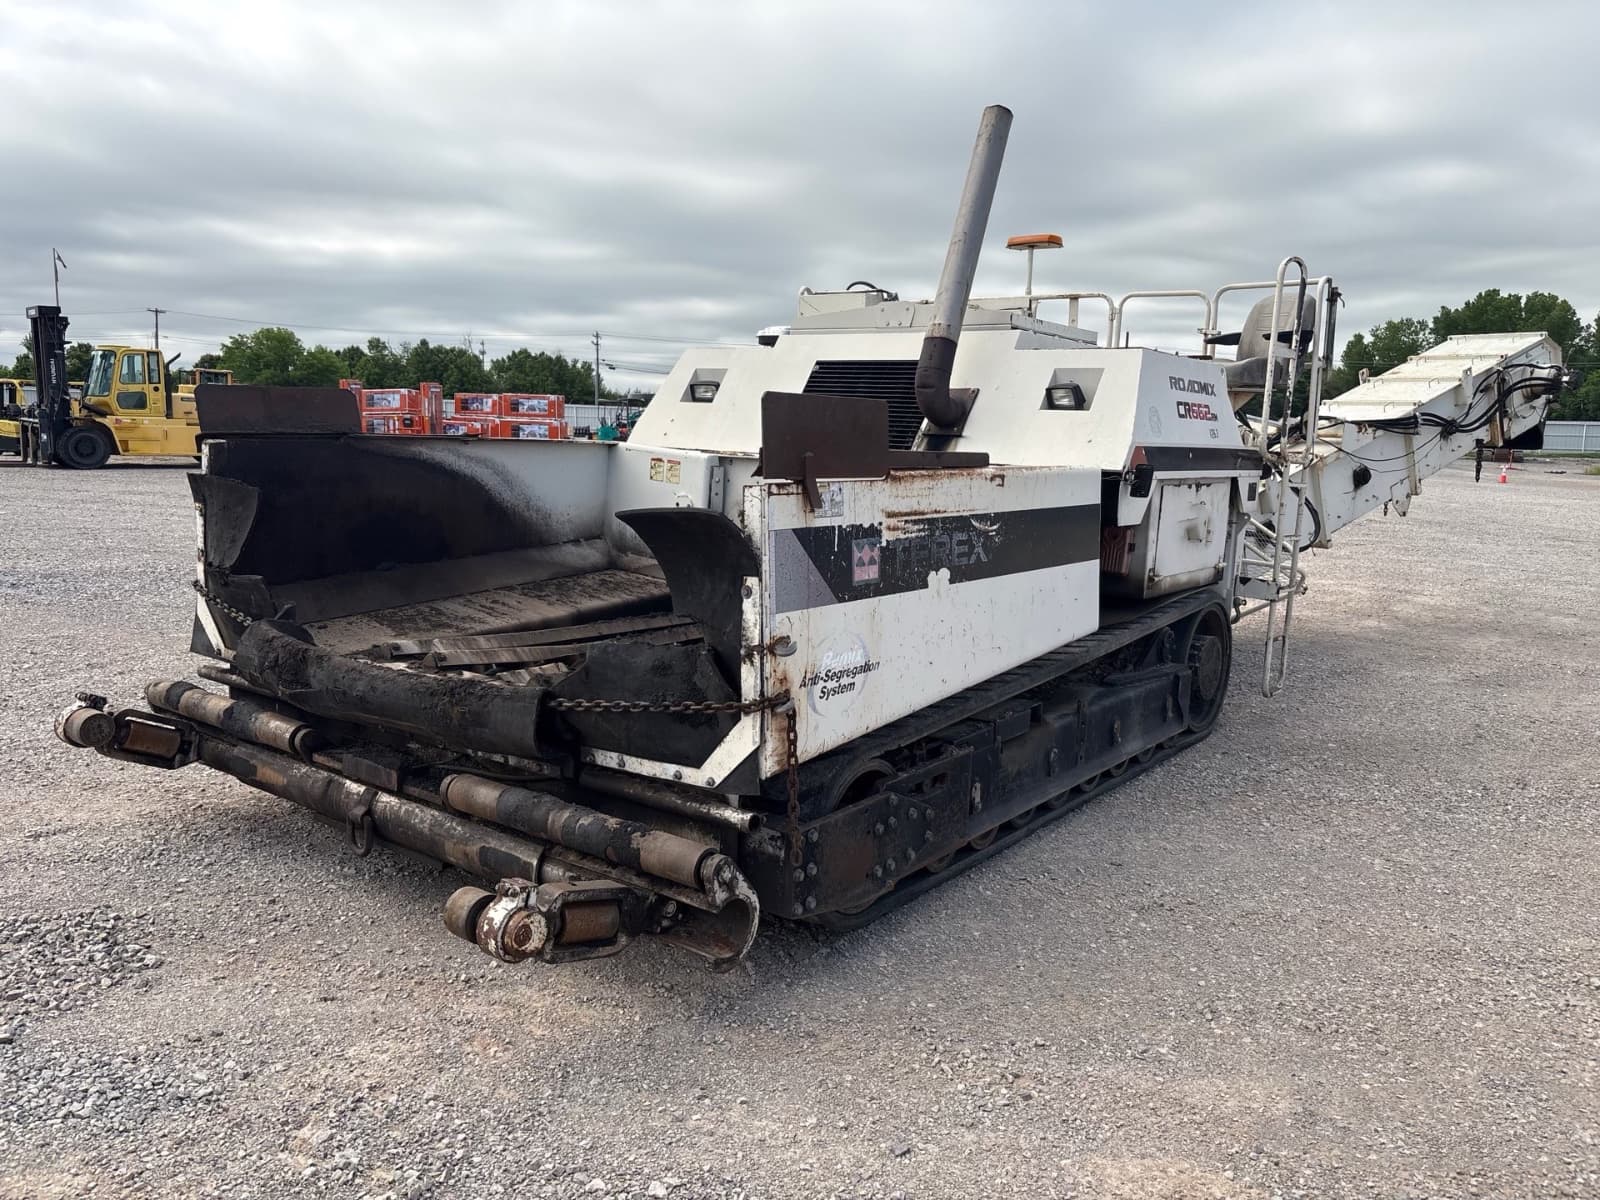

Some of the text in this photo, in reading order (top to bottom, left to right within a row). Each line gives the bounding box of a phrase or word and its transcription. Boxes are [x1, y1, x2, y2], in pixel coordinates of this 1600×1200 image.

[1169, 376, 1217, 397] ROADMIX
[890, 531, 989, 569] TEREX
[799, 659, 880, 689] Anti-Segregation
[819, 682, 856, 701] System
